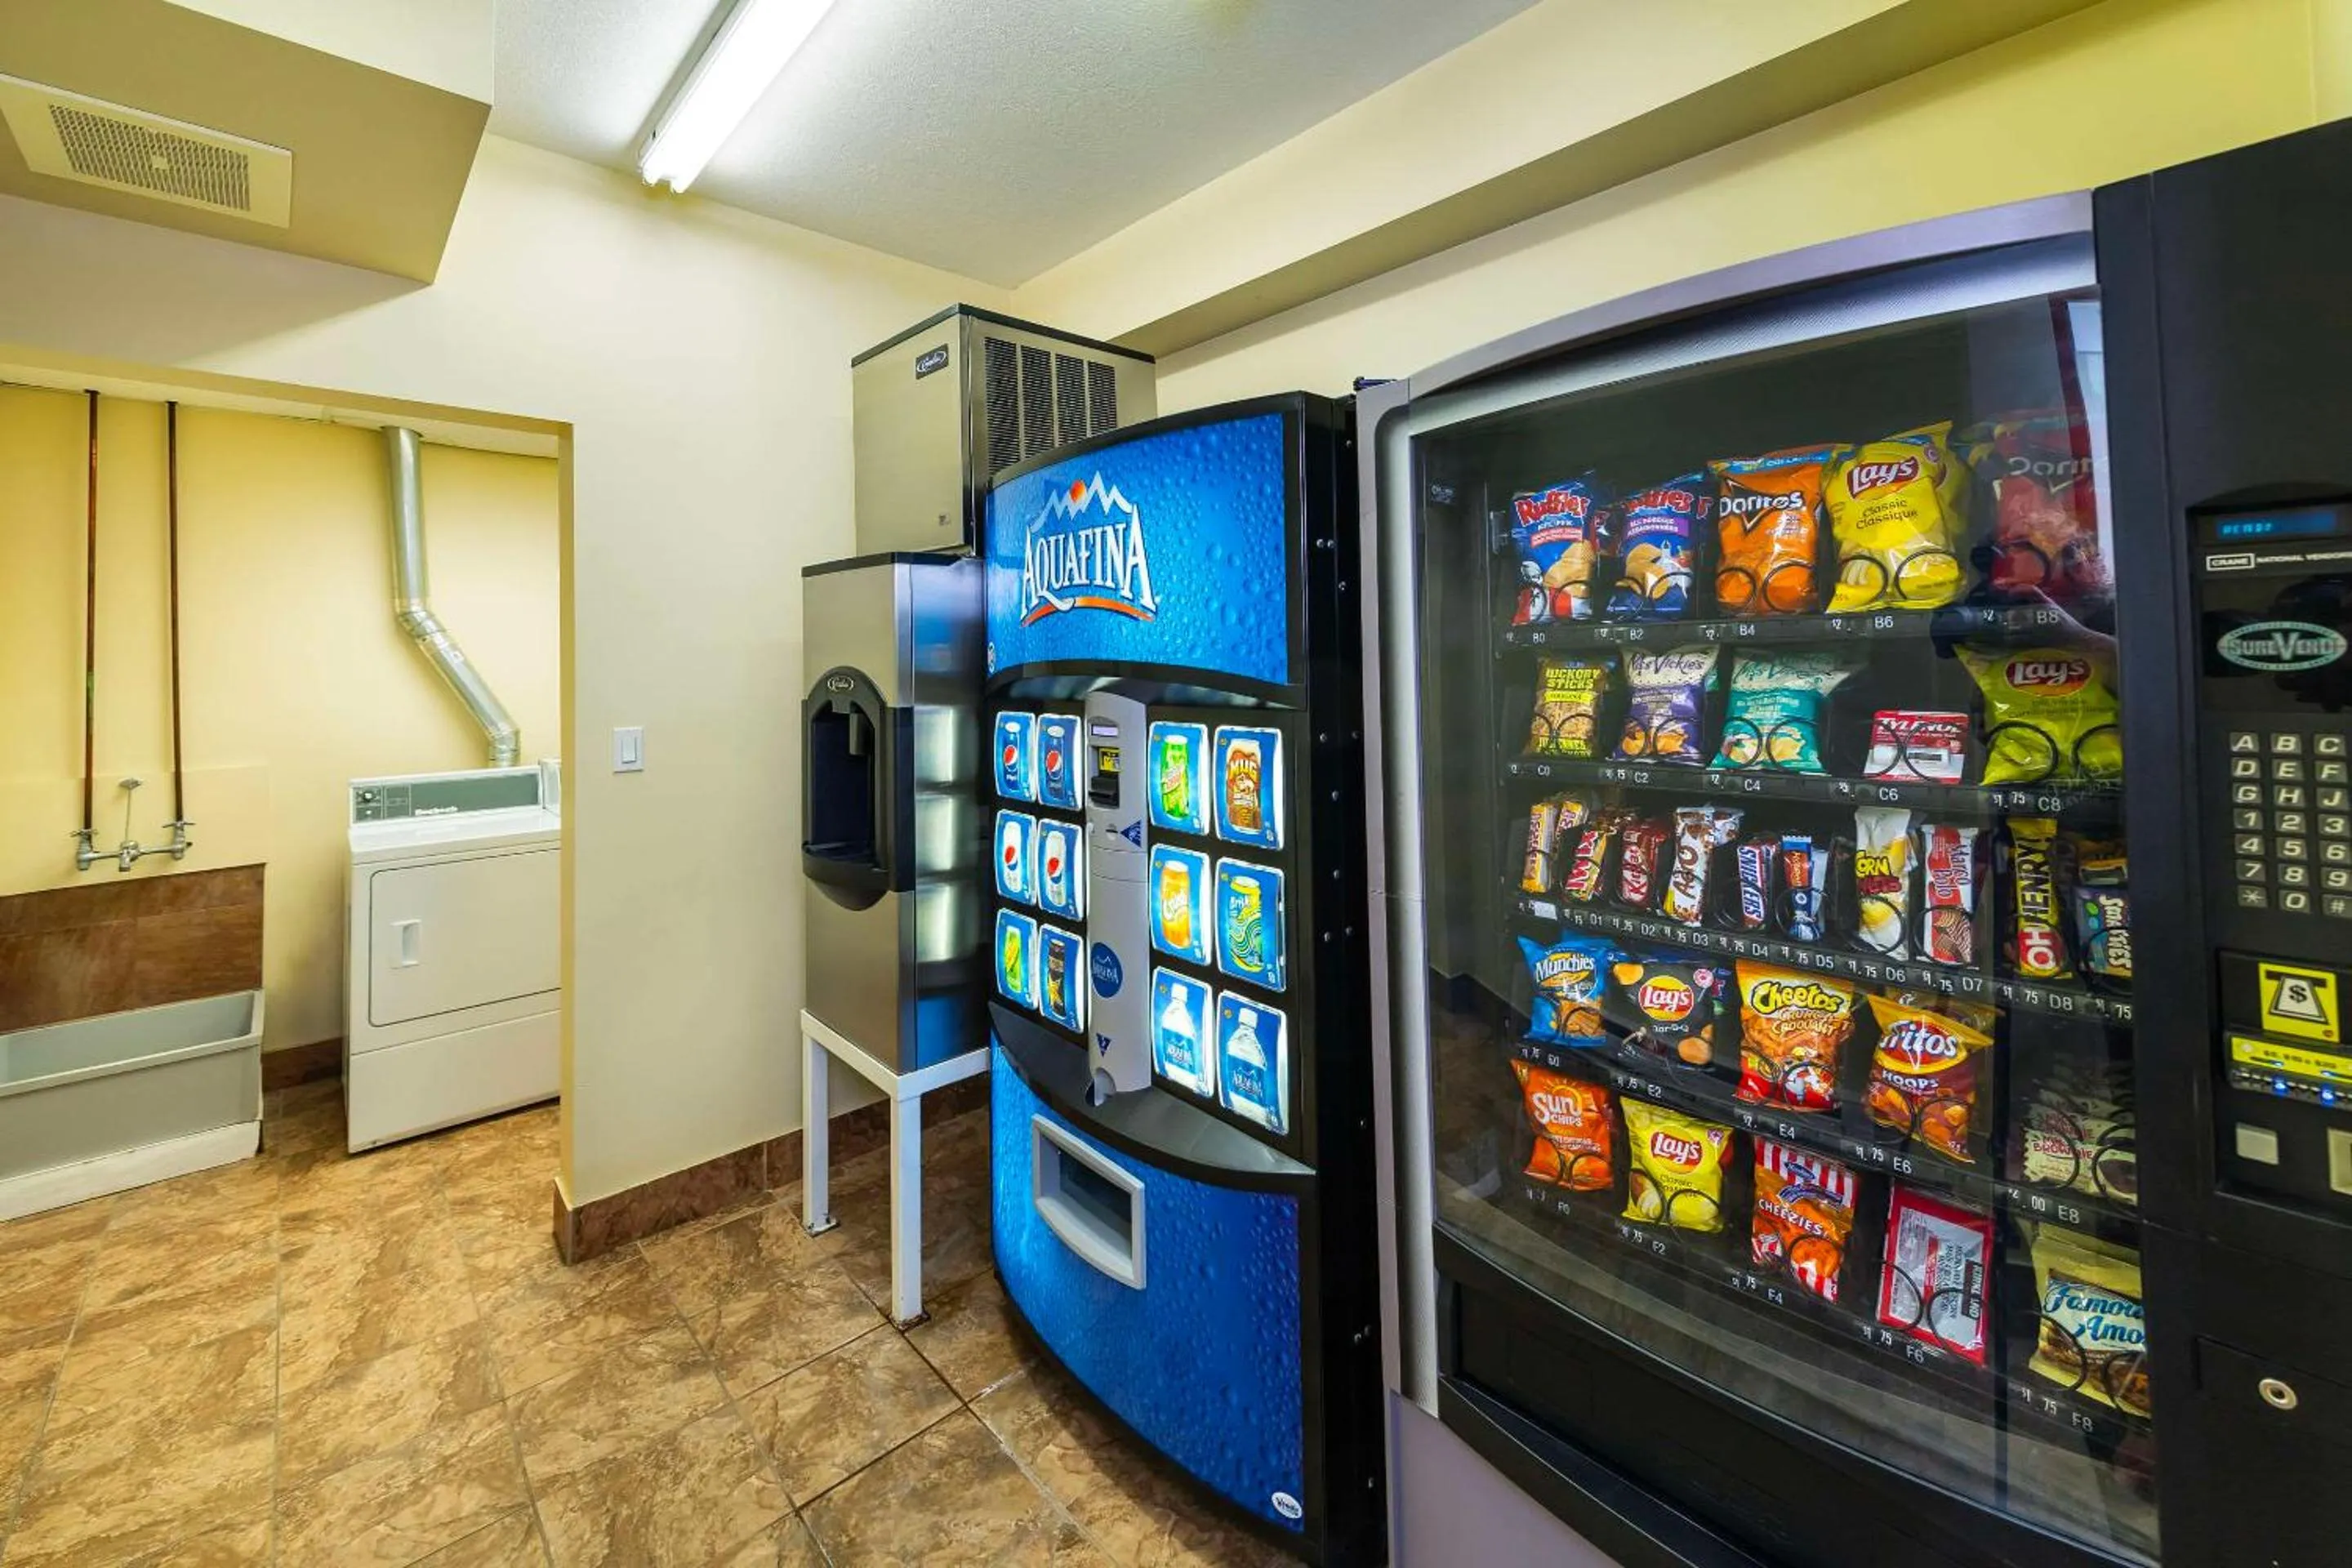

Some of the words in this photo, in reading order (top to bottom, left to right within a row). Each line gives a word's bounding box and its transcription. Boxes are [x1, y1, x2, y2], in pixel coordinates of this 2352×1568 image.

[2009, 456, 2092, 475] Dorit
[1514, 488, 1592, 527] Ruffles
[1719, 492, 1803, 517] Doritos
[1863, 498, 1908, 517] Classic
[1020, 504, 1157, 621] AQUAFINA
[1875, 617, 1893, 629] B6
[2036, 611, 2058, 623] B8
[1630, 629, 1644, 640] B2
[1740, 625, 1755, 636] B4
[1545, 668, 1601, 679] HICKORY
[1546, 679, 1594, 689] STICKS
[2234, 735, 2254, 750] A
[2276, 736, 2296, 751] B
[2319, 737, 2341, 752] C
[1635, 773, 1649, 784] C2
[2236, 760, 2256, 775] D
[2278, 762, 2297, 777] E
[2322, 764, 2341, 779] F
[1744, 779, 1761, 791] C4
[1879, 787, 1899, 800] C6
[2038, 797, 2061, 812] C8
[2238, 786, 2258, 800] G
[2278, 789, 2300, 804] H
[2323, 791, 2341, 806] J
[2244, 812, 2256, 826] 1
[2281, 815, 2301, 830] 2
[2324, 818, 2345, 833] 3
[2242, 838, 2259, 852] 4
[2283, 841, 2301, 856] 5
[2327, 844, 2346, 860] 6
[1855, 850, 1892, 879] CORN
[1950, 844, 1972, 885] Marco
[1739, 848, 1764, 919] SNICKERS
[1935, 870, 1957, 898] Polo
[2245, 863, 2261, 877] 7
[2284, 866, 2304, 882] 8
[2328, 871, 2348, 887] 9
[1590, 913, 1602, 925] D1
[1641, 924, 1655, 936] D2
[1693, 933, 1708, 946] D3
[1753, 944, 1768, 957] D4
[1536, 953, 1595, 983] Munchies
[1815, 955, 1833, 968] D5
[1886, 967, 1906, 982] D6
[1962, 977, 1983, 991] D7
[1751, 980, 1845, 1014] Cheetos
[2049, 994, 2073, 1011] D8
[1880, 1020, 1958, 1057] Fritos
[1882, 1068, 1940, 1089] HOOPS
[1647, 1085, 1662, 1098] E2
[1533, 1092, 1583, 1125] Sun
[1779, 1124, 1795, 1139] E4
[1893, 1156, 1913, 1174] E6
[1758, 1199, 1823, 1236] CHEEZIES
[2058, 1205, 2080, 1223] E8
[1652, 1241, 1666, 1255] F2
[1767, 1288, 1783, 1304] F4
[2044, 1284, 2145, 1319] Famou
[2075, 1315, 2145, 1344] Amo
[1906, 1345, 1924, 1364] F6
[2072, 1412, 2093, 1432] F8
